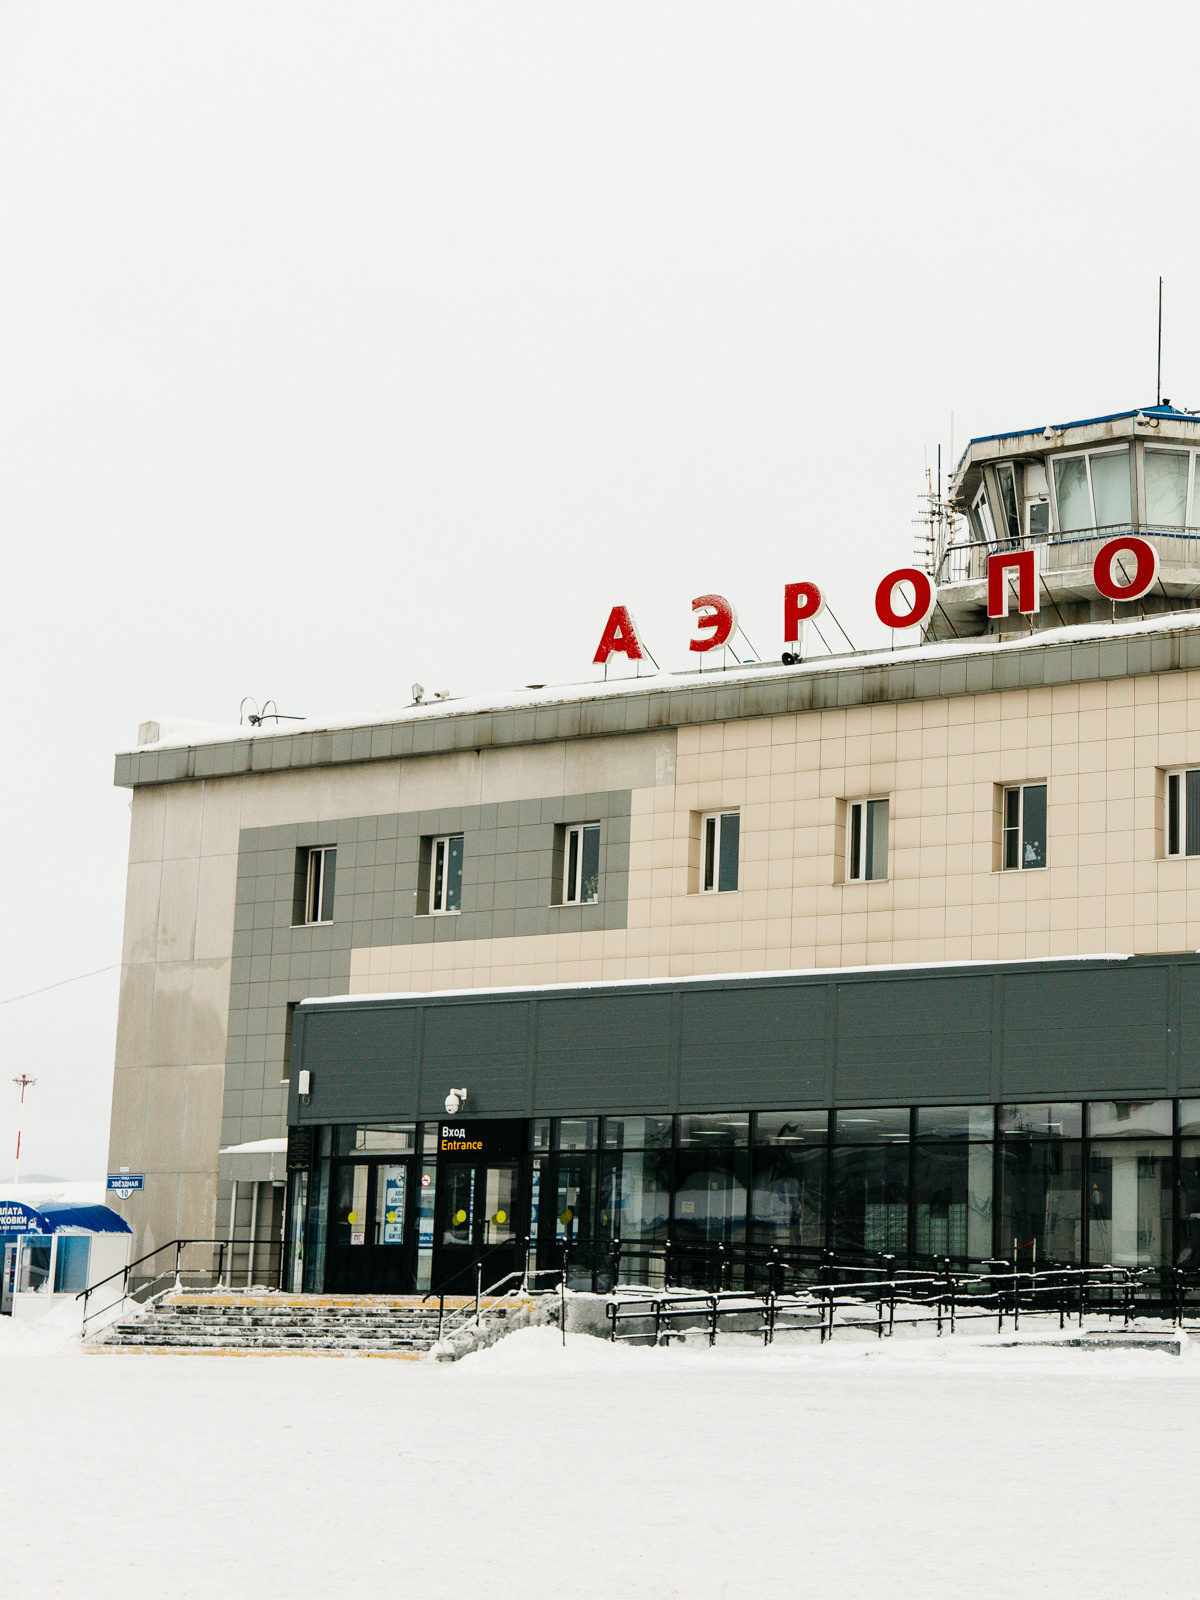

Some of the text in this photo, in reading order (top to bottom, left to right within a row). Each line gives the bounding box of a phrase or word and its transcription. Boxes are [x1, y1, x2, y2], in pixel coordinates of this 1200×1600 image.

[442, 1126, 466, 1139] Вход
[441, 1139, 483, 1151] Entrance
[121, 1189, 129, 1198] 10
[0, 1216, 27, 1225] КОВКИ
